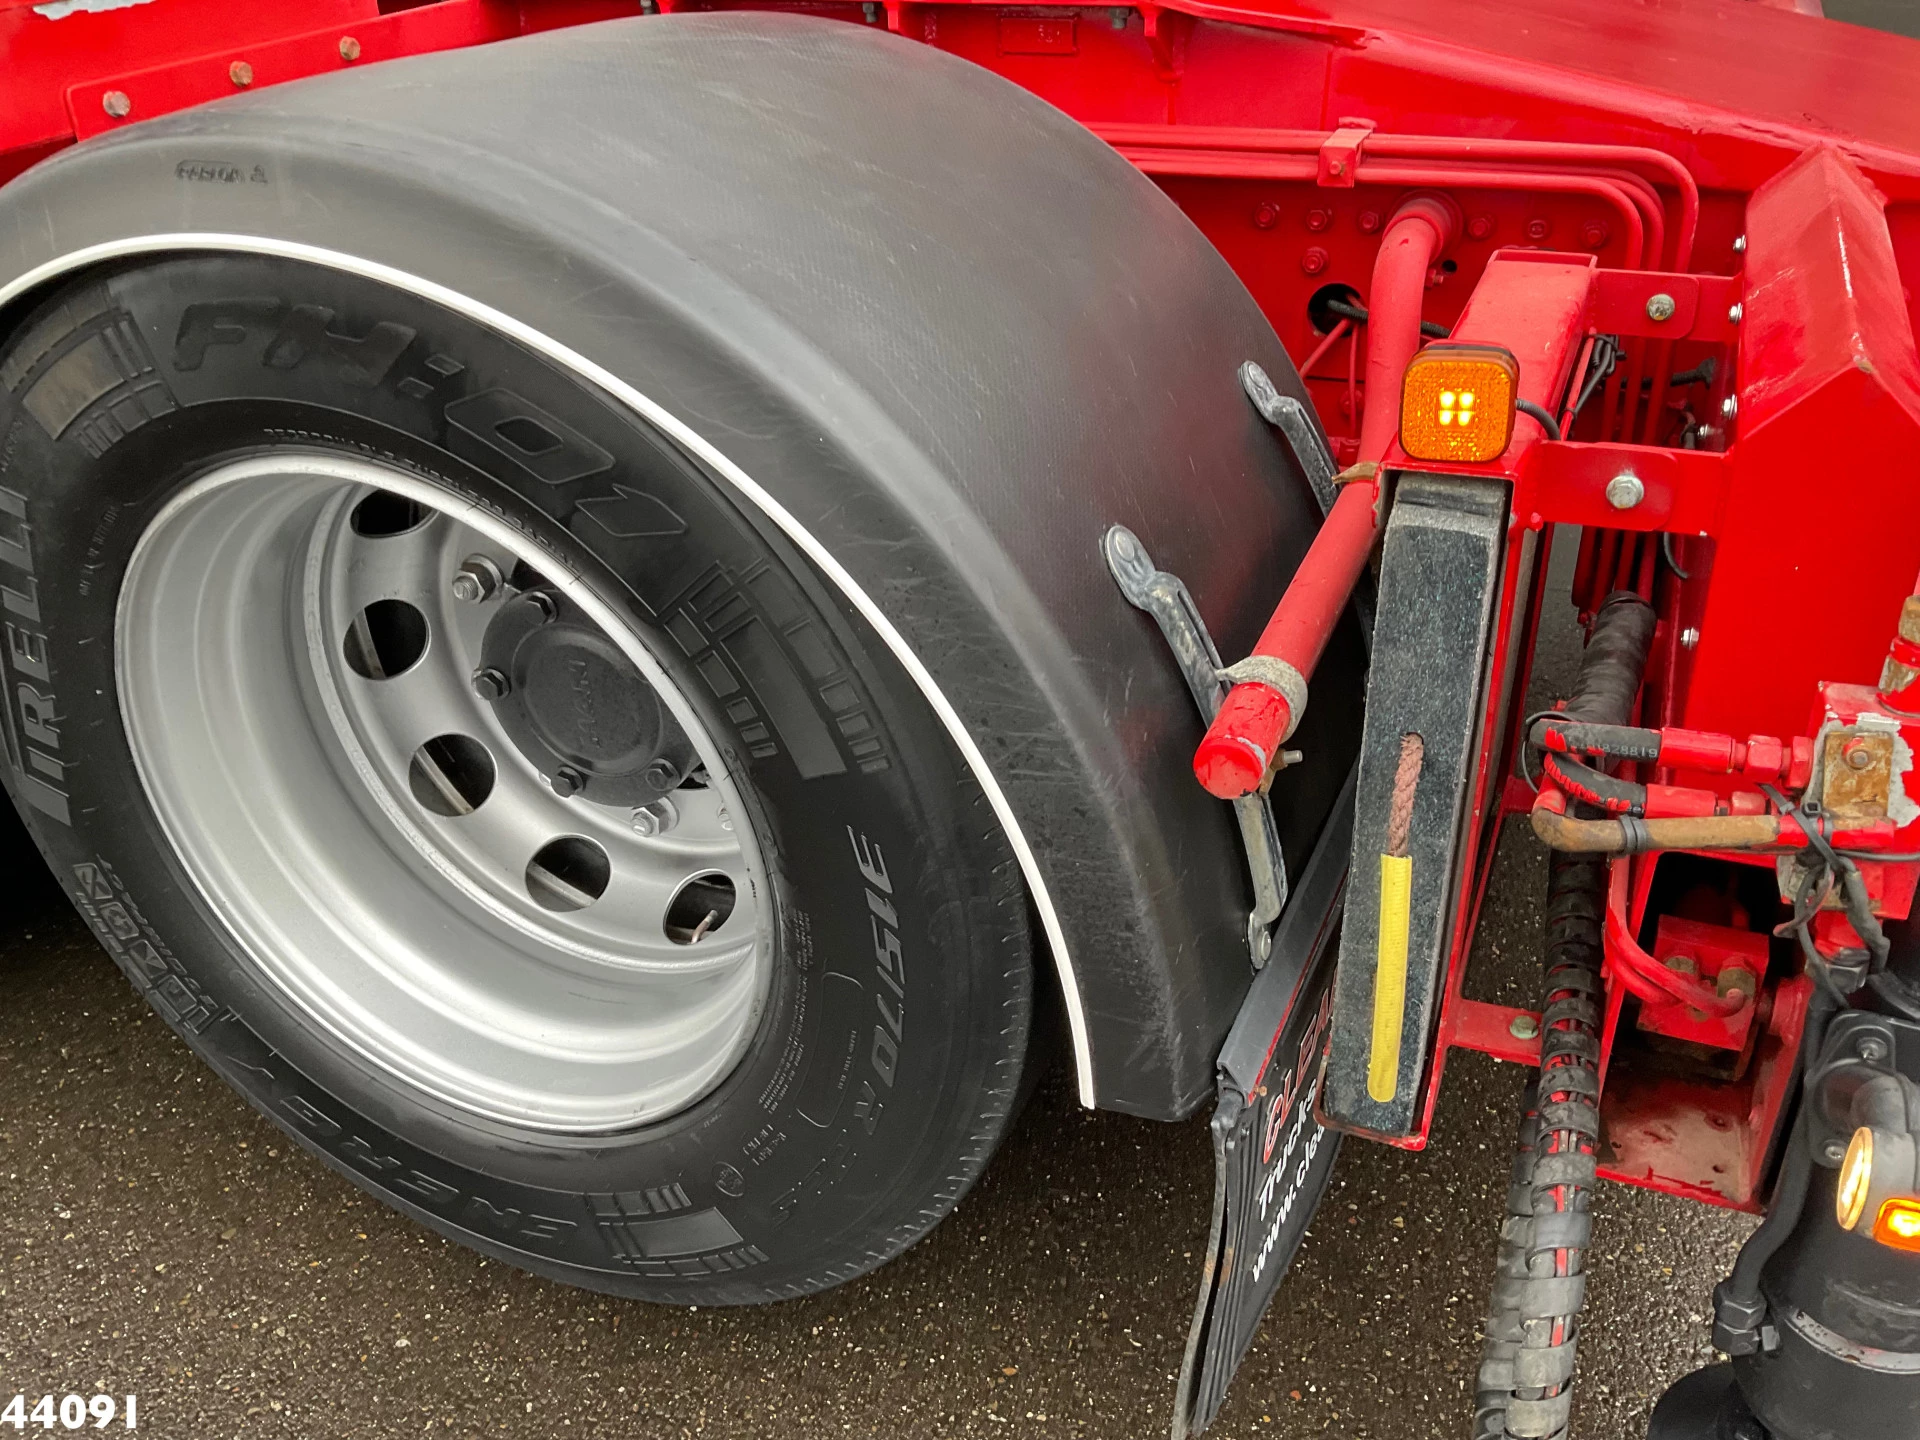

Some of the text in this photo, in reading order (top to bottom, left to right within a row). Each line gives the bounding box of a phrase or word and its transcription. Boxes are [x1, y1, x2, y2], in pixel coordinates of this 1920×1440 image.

[0, 484, 73, 828] PIRELLI
[846, 824, 906, 1088] 315/70
[1259, 1078, 1317, 1221] Trucks
